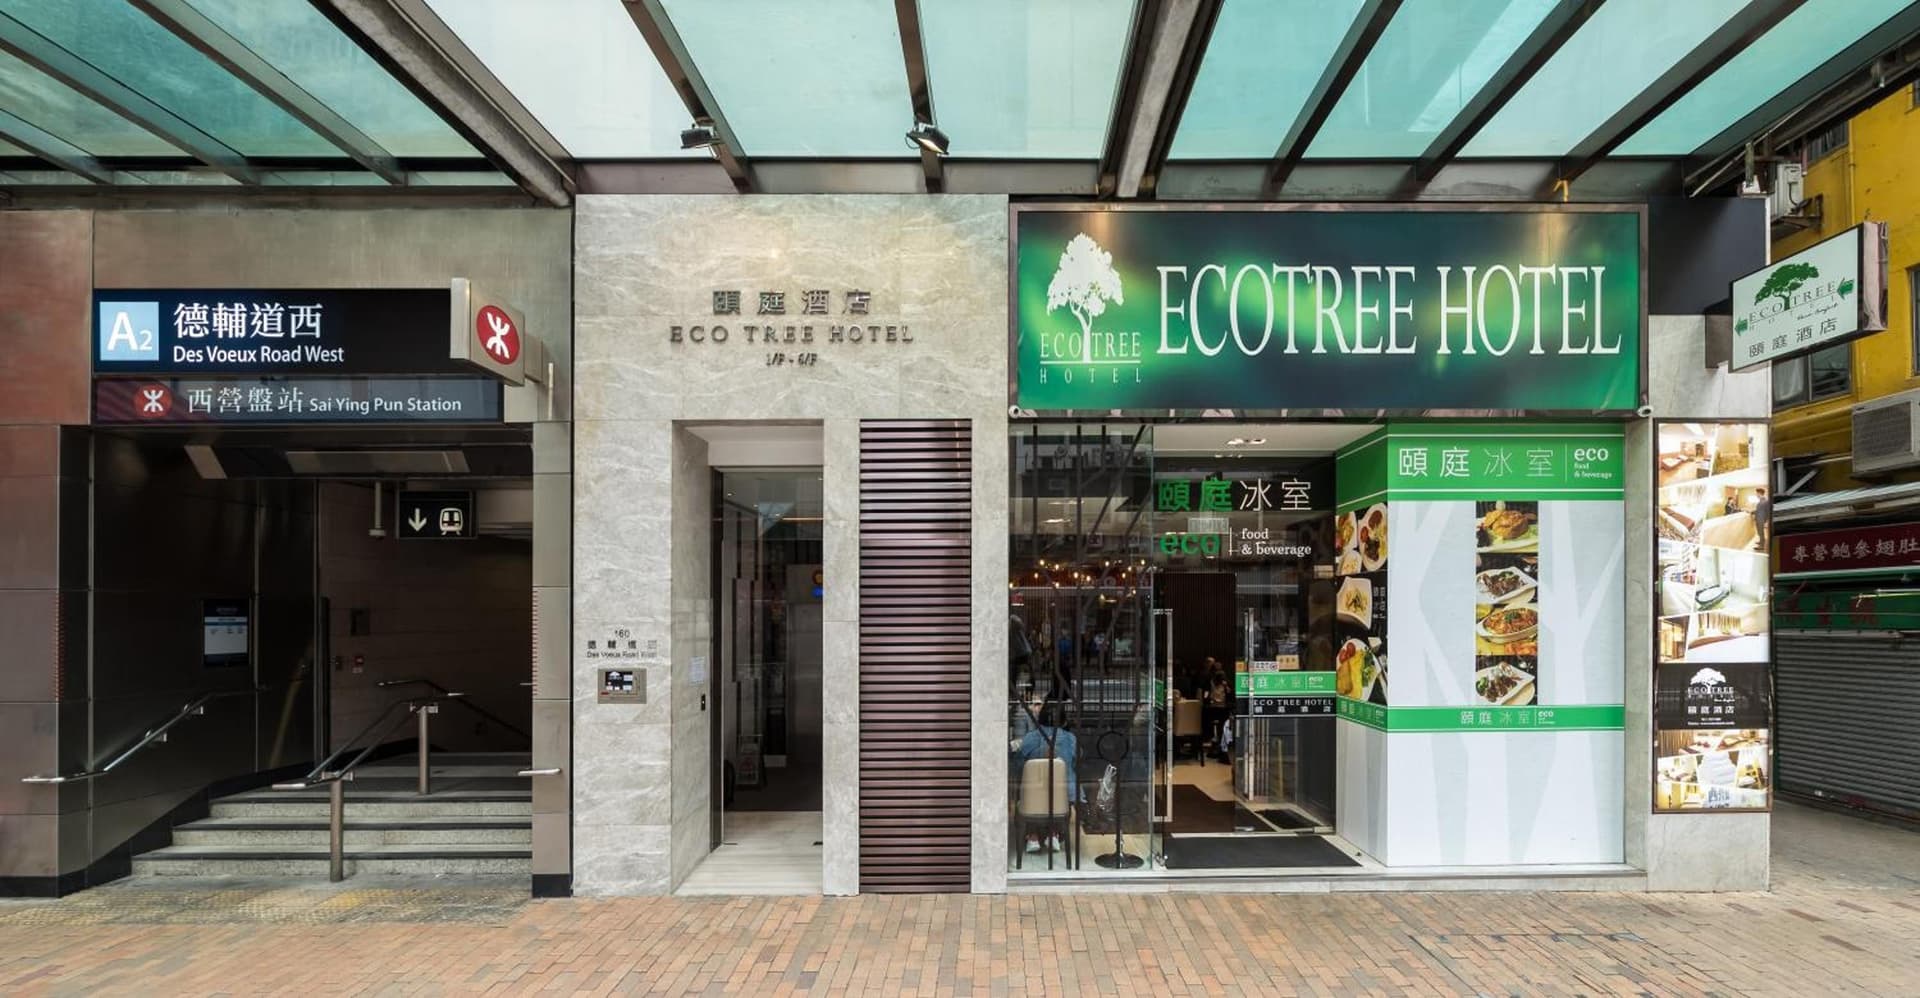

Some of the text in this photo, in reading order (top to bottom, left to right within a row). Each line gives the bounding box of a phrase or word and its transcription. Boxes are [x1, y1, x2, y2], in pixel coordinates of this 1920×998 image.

[713, 289, 871, 315] 頤庭酒店
[1156, 262, 1622, 357] ECOTREE HOTEL
[107, 311, 152, 351] A2
[173, 302, 323, 339] 德輔道西
[670, 325, 914, 344] ECO TREE HOTEL
[173, 346, 344, 363] Des Voeux Road West
[766, 353, 785, 367] 1/F
[797, 353, 818, 367] 6/F
[1040, 367, 1141, 384] HOTEL
[187, 386, 304, 414] 西營盤站
[309, 398, 462, 415] Sai Ying Pun Station
[1399, 446, 1555, 478] 頤庭冰室
[1574, 448, 1609, 461] eco
[1158, 477, 1313, 513] 頤庭冰室
[1159, 533, 1221, 556] eco
[1241, 528, 1269, 540] food
[1241, 541, 1312, 557] & beverage
